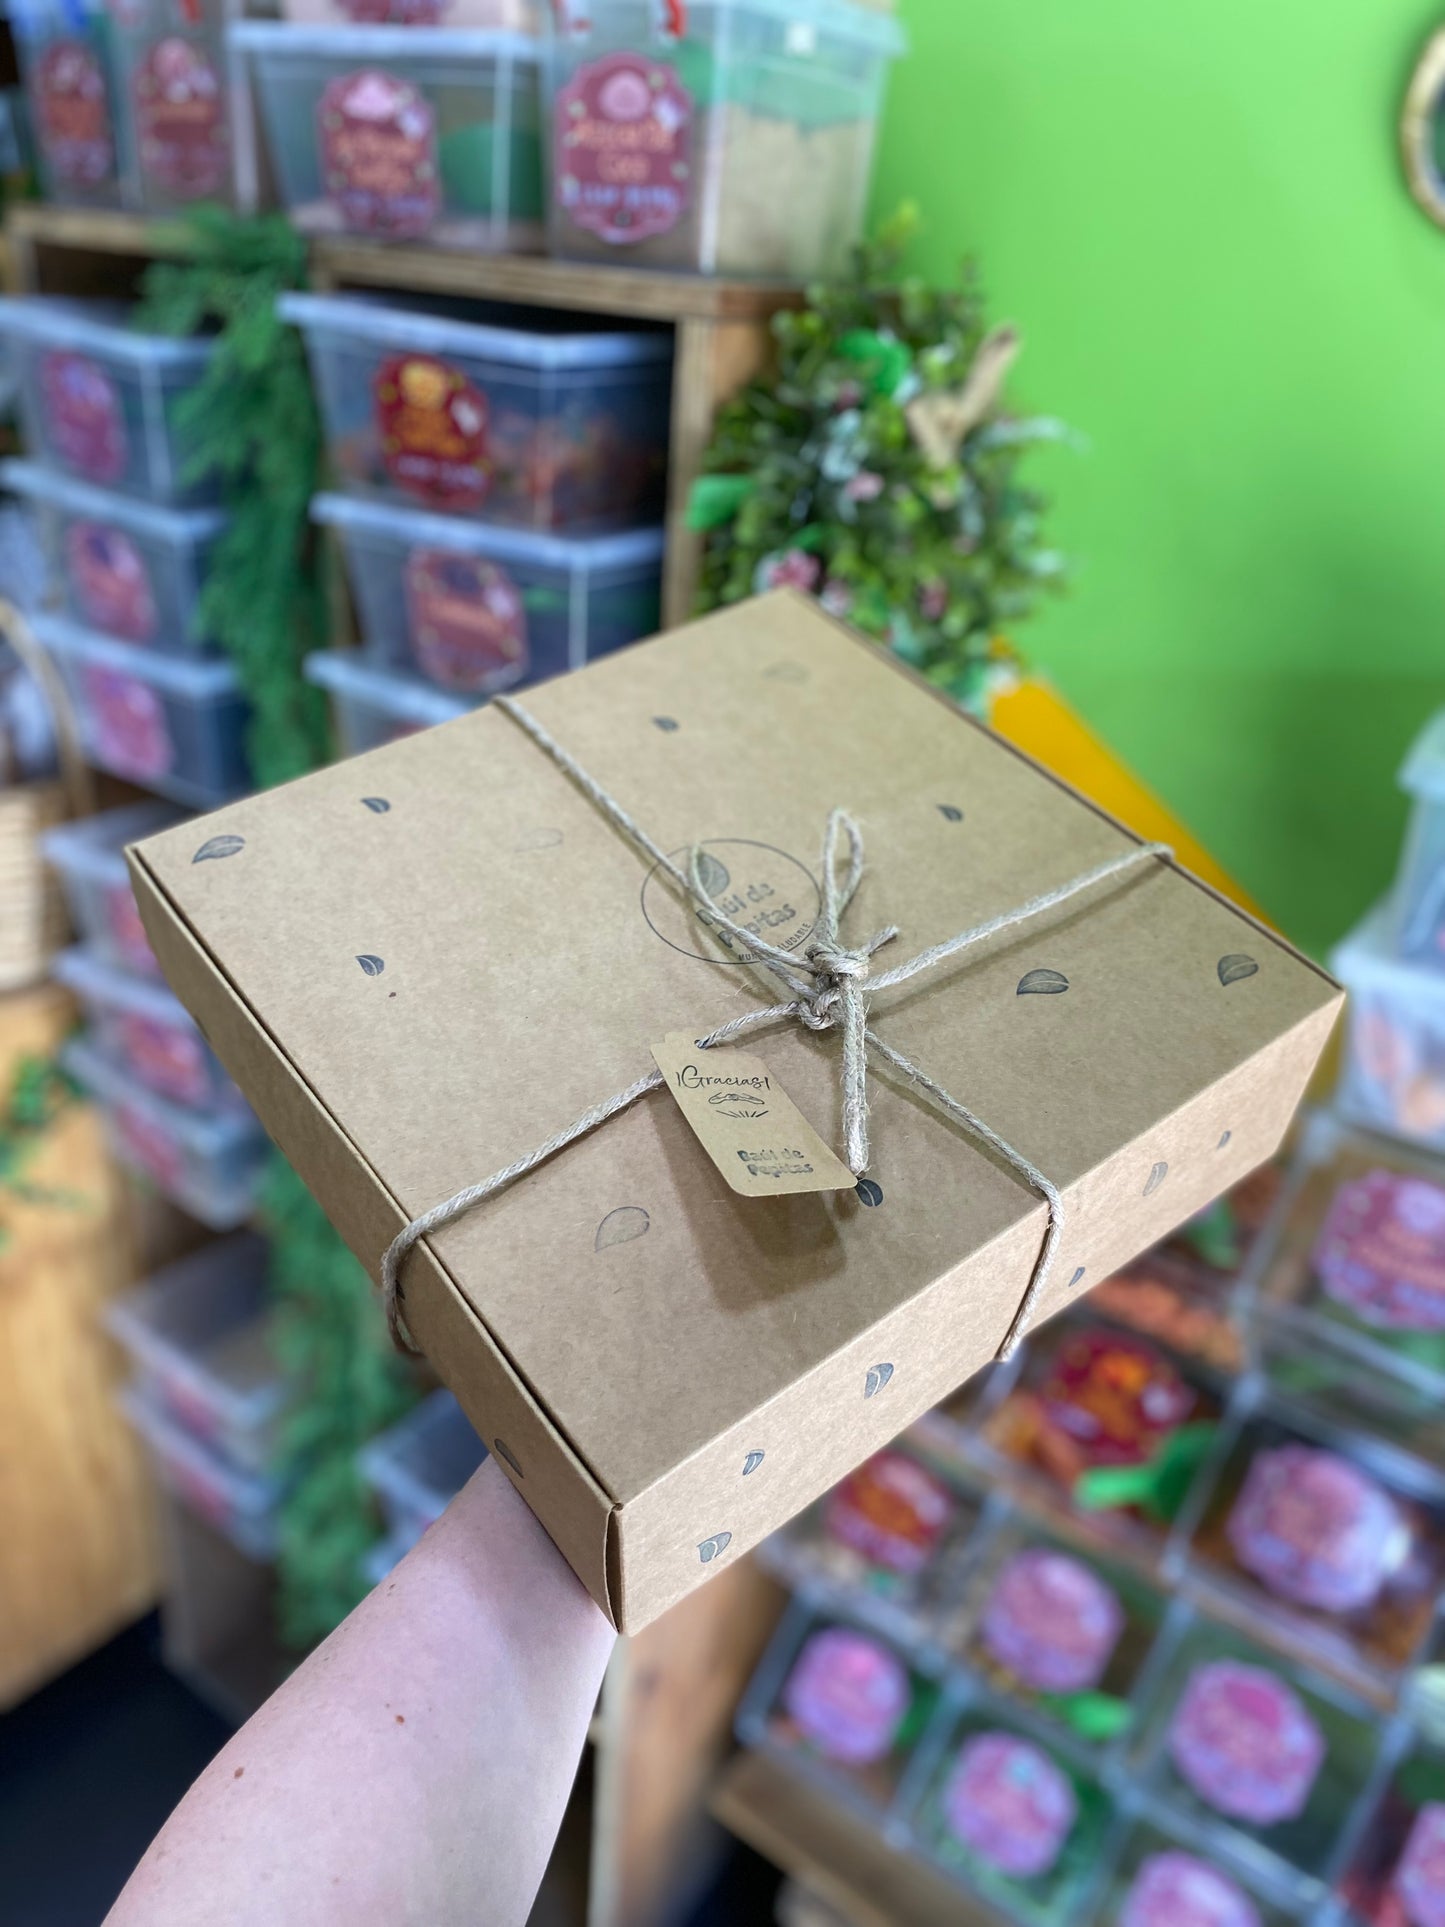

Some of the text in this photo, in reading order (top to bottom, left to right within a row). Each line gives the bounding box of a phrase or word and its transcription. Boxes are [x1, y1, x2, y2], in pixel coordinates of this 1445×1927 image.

[746, 883, 775, 902] de
[737, 1147, 805, 1162] Baúl de
[747, 1163, 814, 1178] Pepitas
